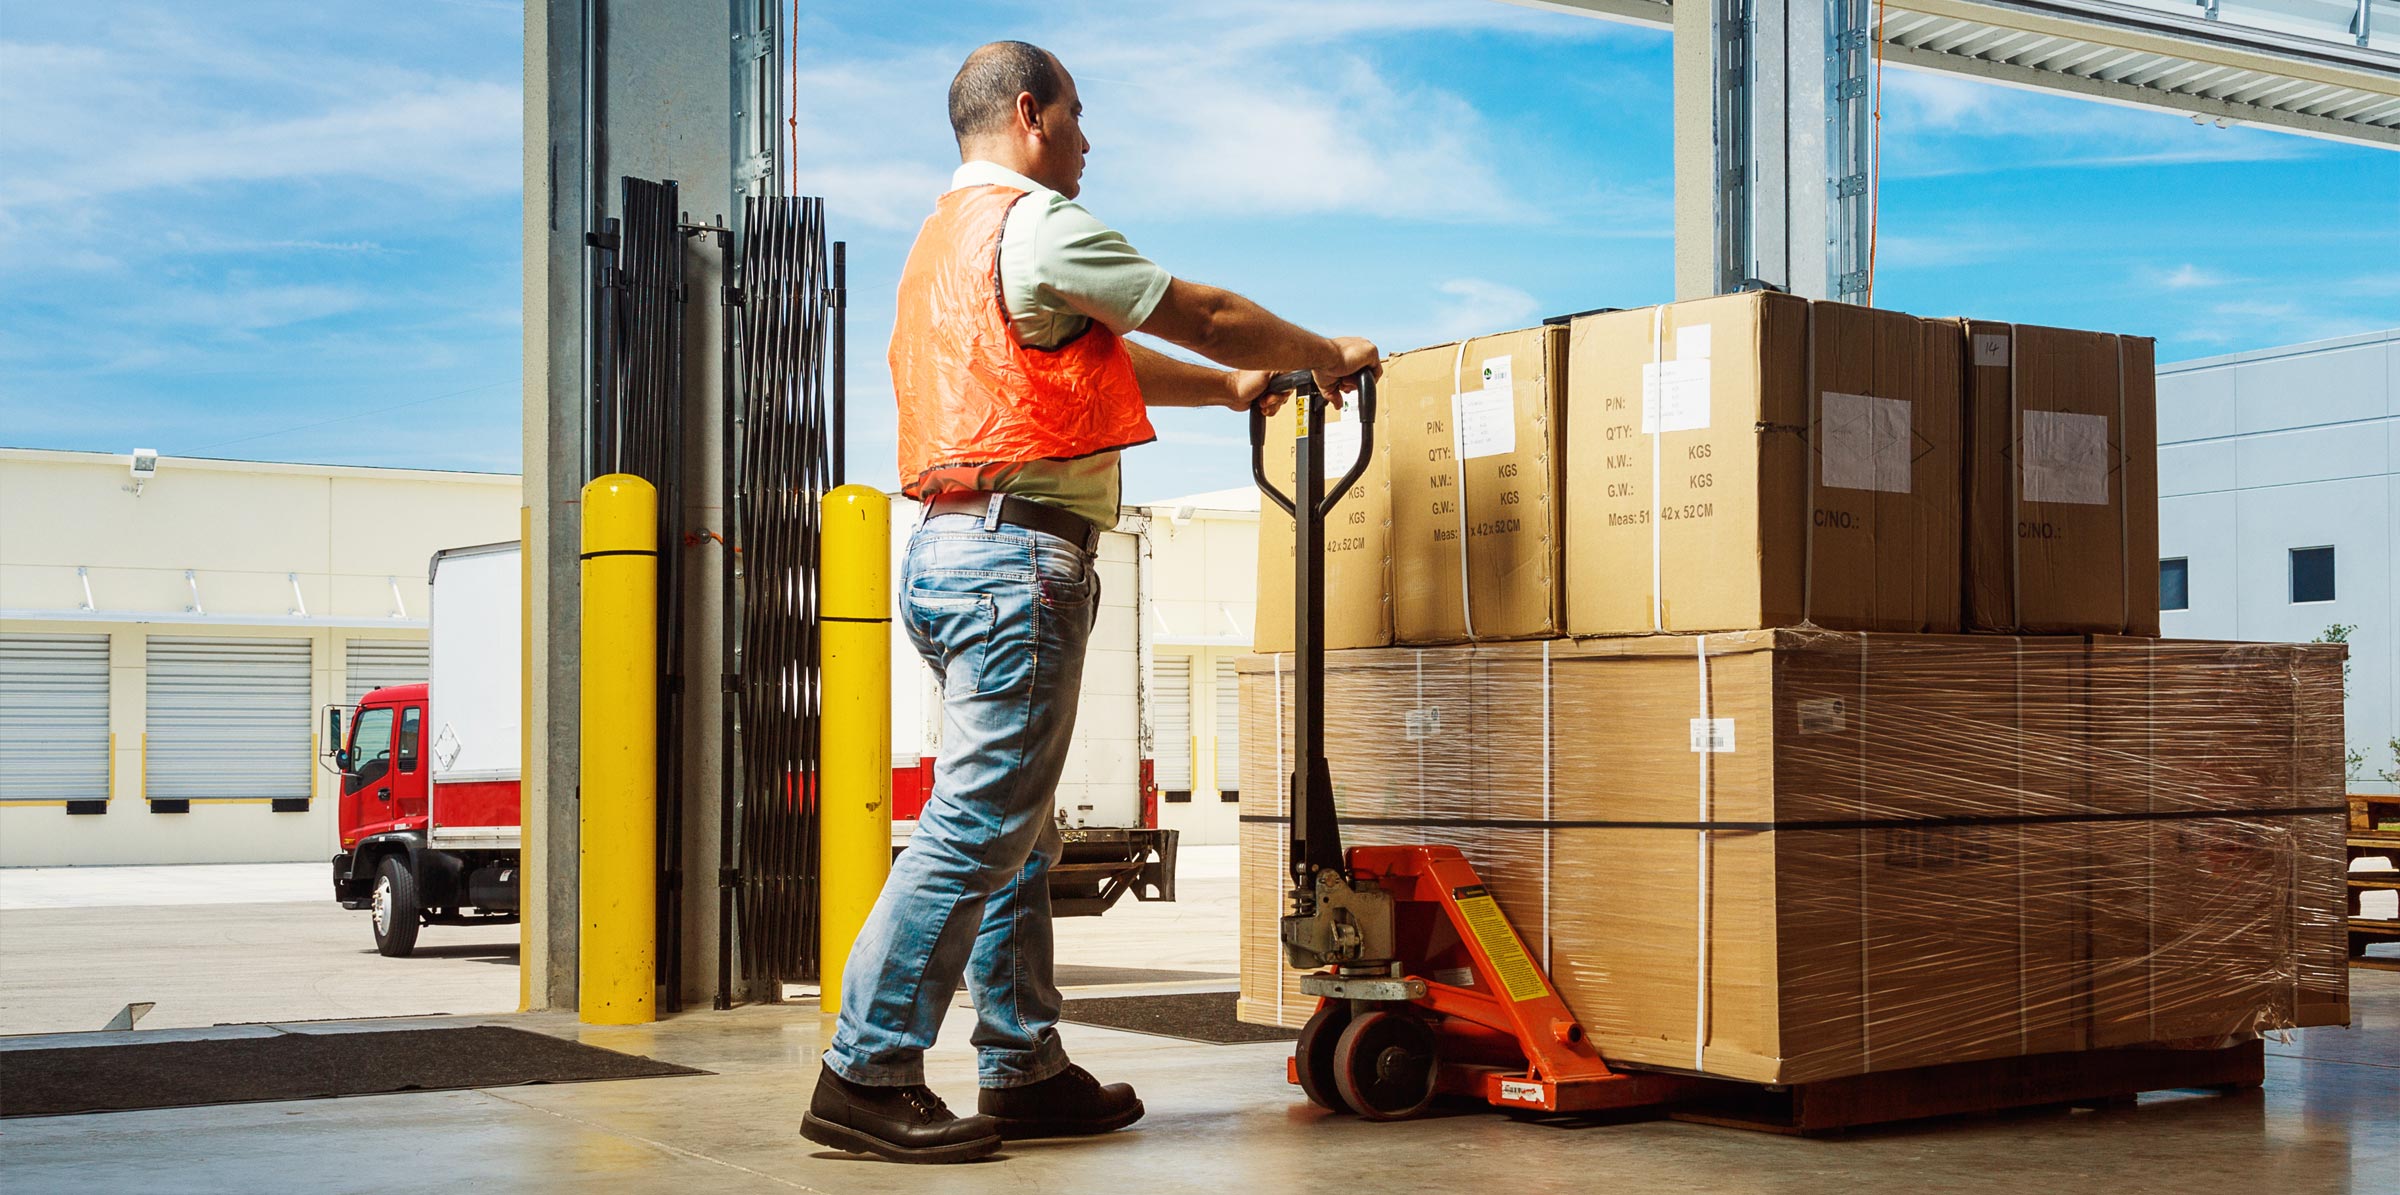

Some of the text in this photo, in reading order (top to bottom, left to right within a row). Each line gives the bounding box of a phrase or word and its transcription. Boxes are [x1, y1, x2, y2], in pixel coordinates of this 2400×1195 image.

[1605, 397, 1626, 411] P/N:
[1427, 420, 1444, 434] P/N:
[1606, 425, 1632, 440] Q'TY:
[1428, 447, 1451, 461] Q'TY:
[1607, 444, 1712, 469] N.W.: KGS
[1430, 463, 1518, 488] N.W.: KGS
[1348, 486, 1365, 499] KGS
[1607, 473, 1713, 498] G.W.: KGS
[1432, 490, 1520, 515] G.W.: KGS
[1349, 511, 1365, 525] KGS
[1608, 513, 1638, 527] Meas:
[1639, 510, 1650, 524] 51
[1814, 509, 1859, 529] C/NO.:
[1433, 528, 1458, 542] Meas:
